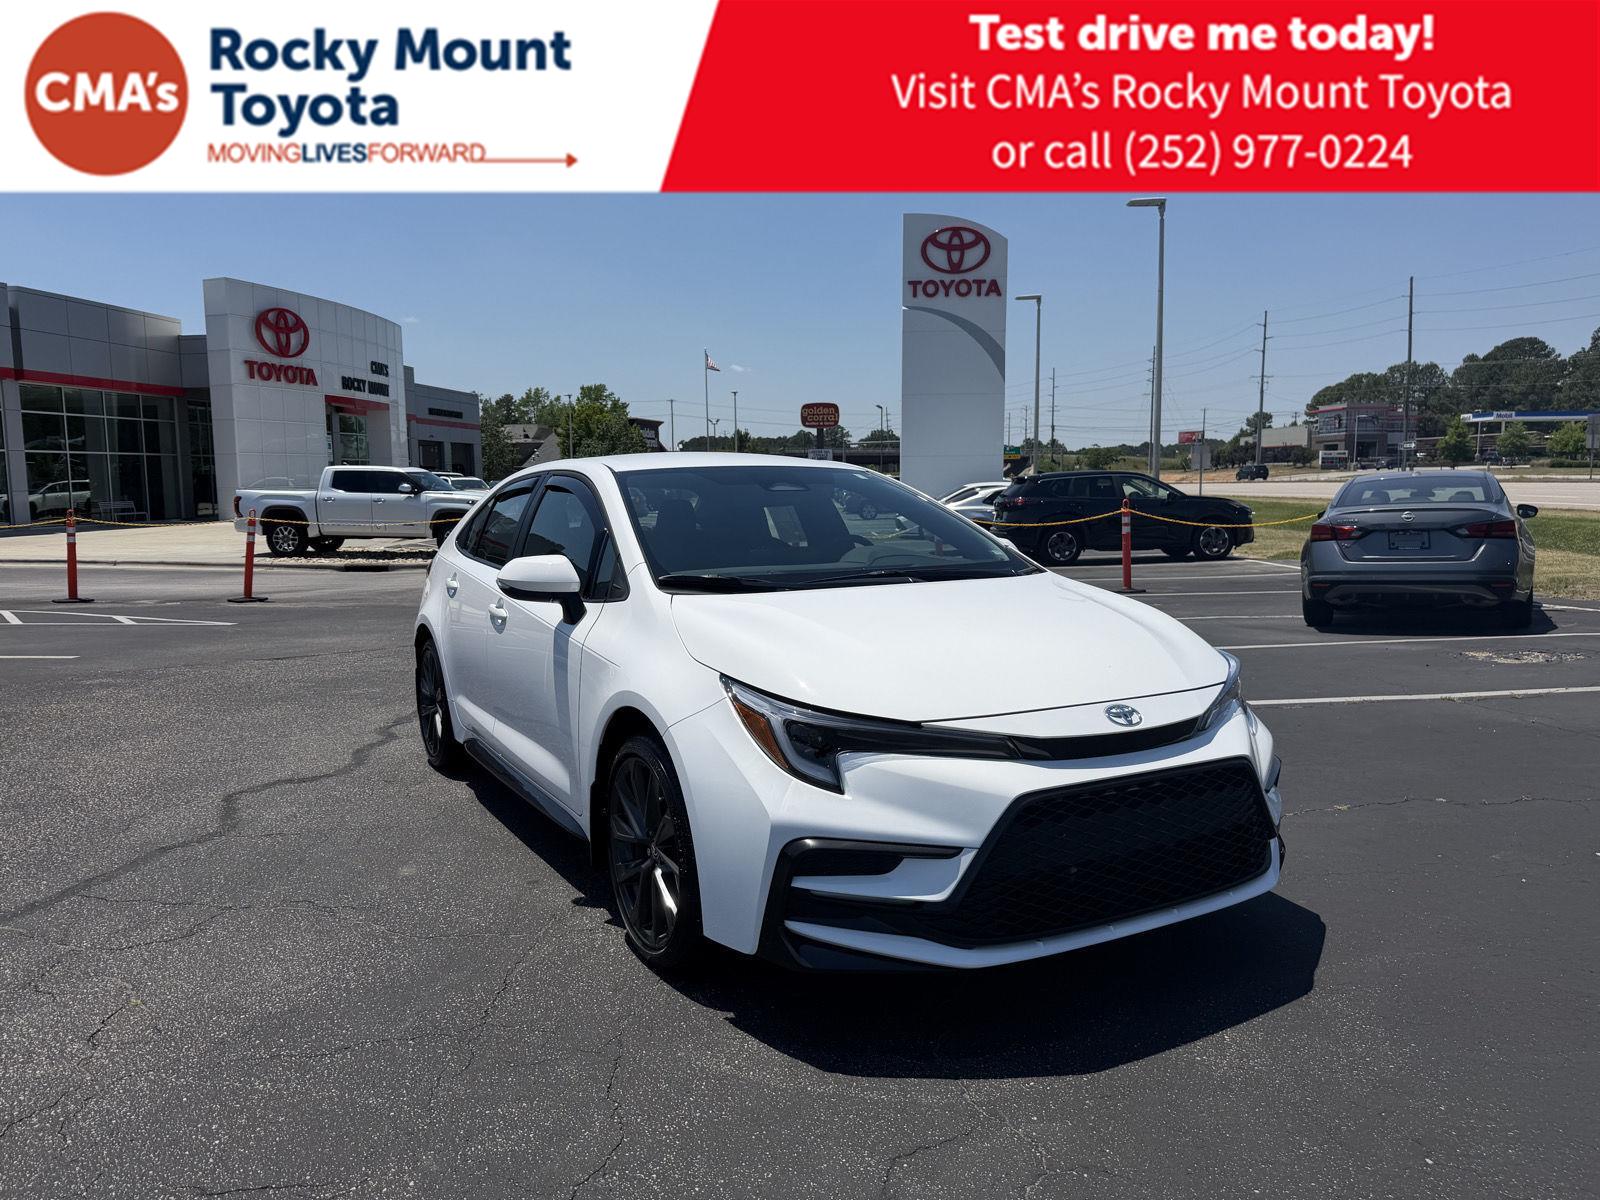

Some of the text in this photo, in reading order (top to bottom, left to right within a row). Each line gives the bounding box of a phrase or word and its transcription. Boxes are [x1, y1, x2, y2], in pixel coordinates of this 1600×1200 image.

[908, 279, 1002, 298] TOYOTA
[244, 360, 318, 386] TOYOTA
[341, 375, 366, 392] ROCKY
[802, 406, 835, 416] golden
[807, 413, 838, 421] corral
[1495, 411, 1513, 419] Mobil
